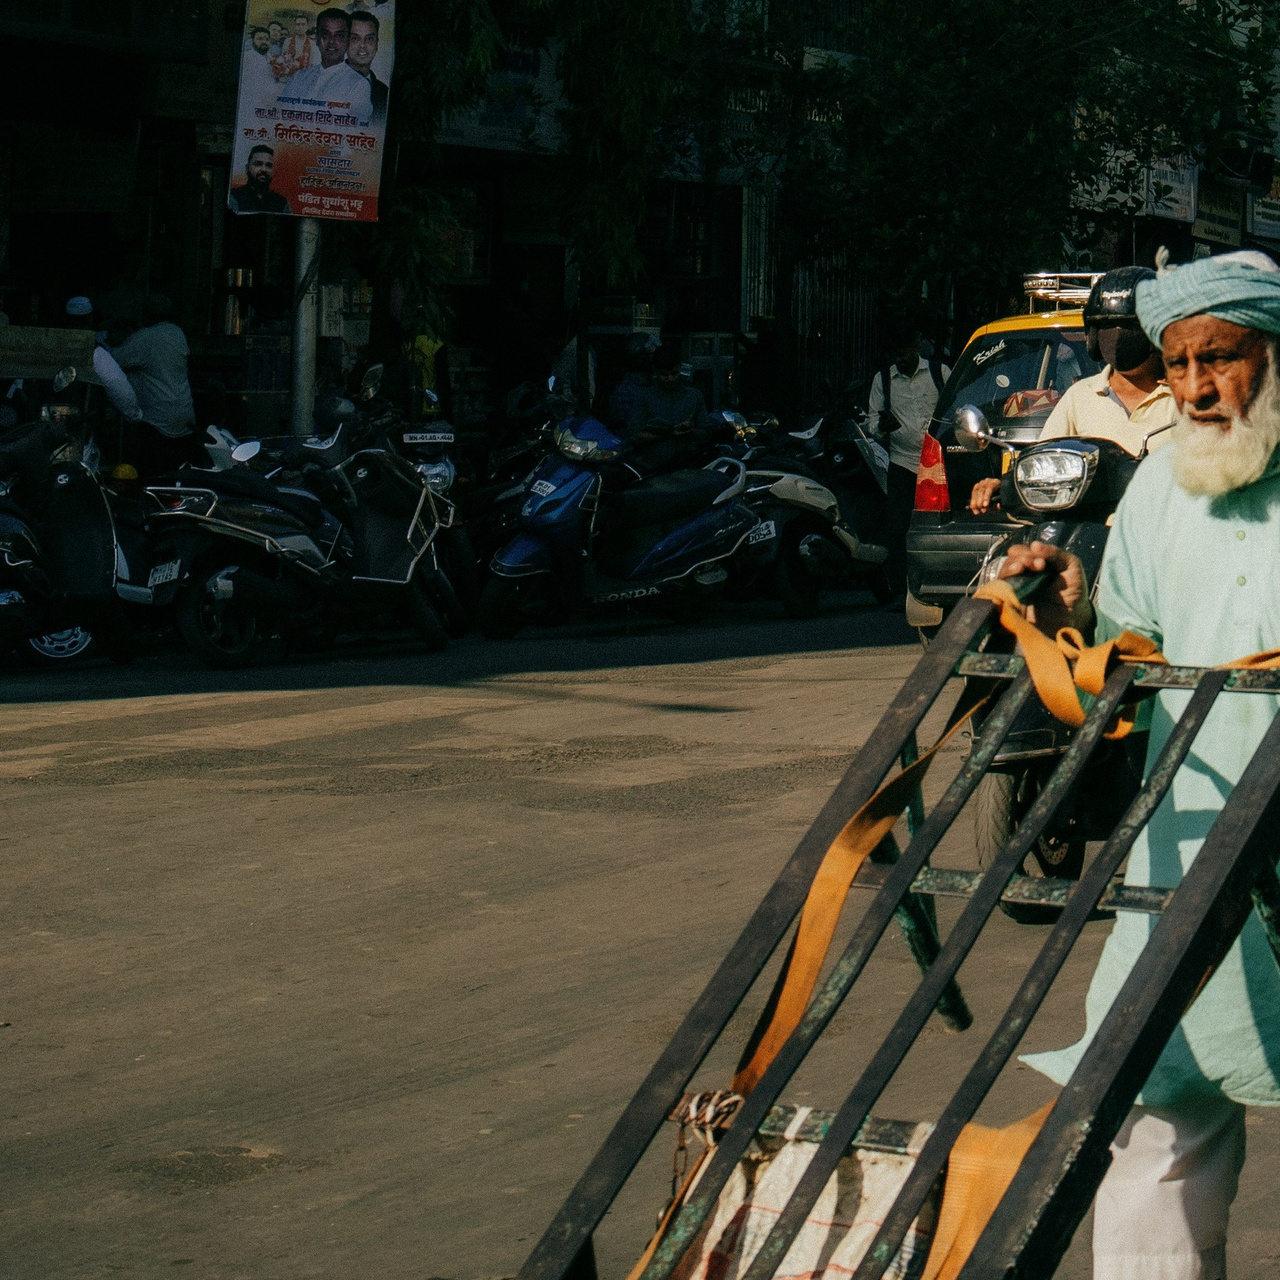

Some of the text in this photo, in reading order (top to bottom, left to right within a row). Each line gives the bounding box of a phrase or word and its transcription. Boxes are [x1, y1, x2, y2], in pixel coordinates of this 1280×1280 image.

[281, 109, 313, 122] एकनाथ
[334, 113, 358, 126] साहेब
[274, 123, 313, 144] मिलिंद
[314, 128, 343, 146] देवरा
[345, 132, 376, 150] साहेब
[317, 156, 352, 168] खासदार
[297, 192, 320, 205] पंडित
[973, 339, 1007, 365] Krish
[594, 586, 661, 603] HONDA
